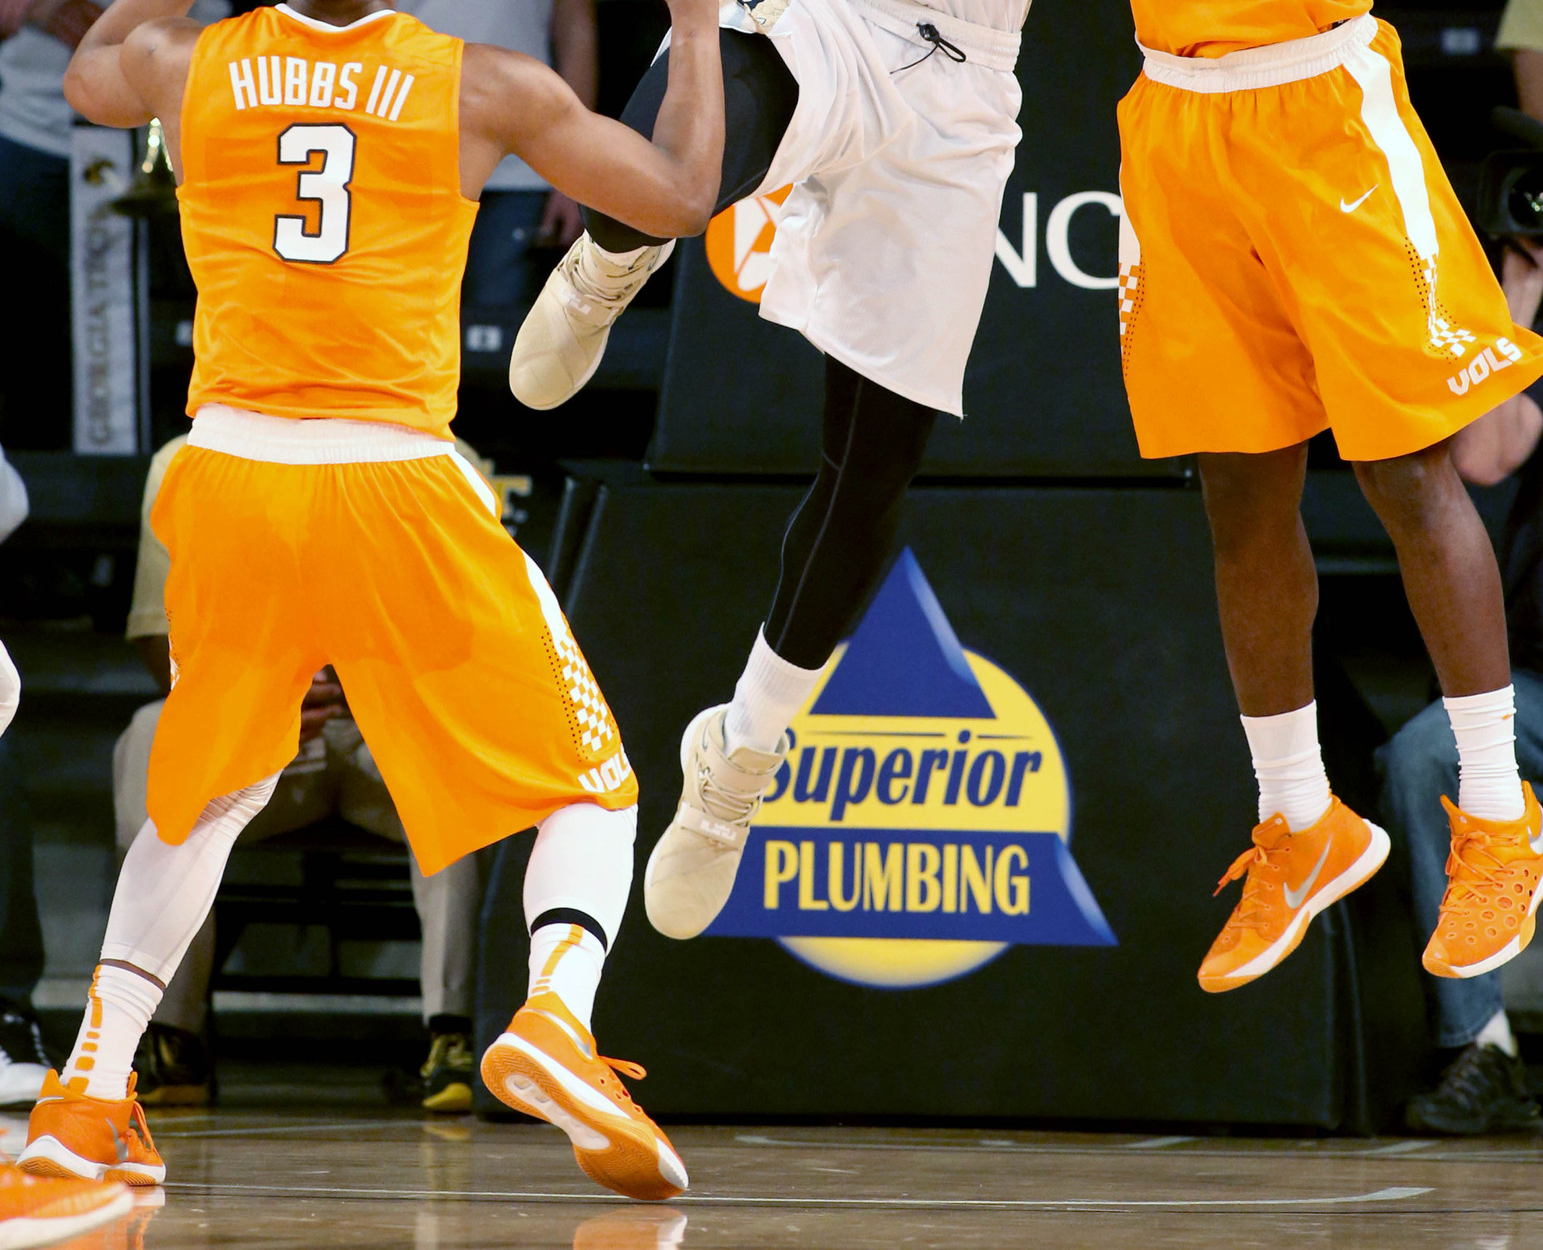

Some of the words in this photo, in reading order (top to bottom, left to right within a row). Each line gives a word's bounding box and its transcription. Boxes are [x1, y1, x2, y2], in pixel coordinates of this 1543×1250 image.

[228, 55, 363, 111] HUBBS
[365, 64, 415, 122] III
[271, 122, 357, 265] 3
[996, 190, 1121, 290] NC
[1446, 336, 1523, 396] VOLS
[764, 840, 1031, 916] PLUMBING
